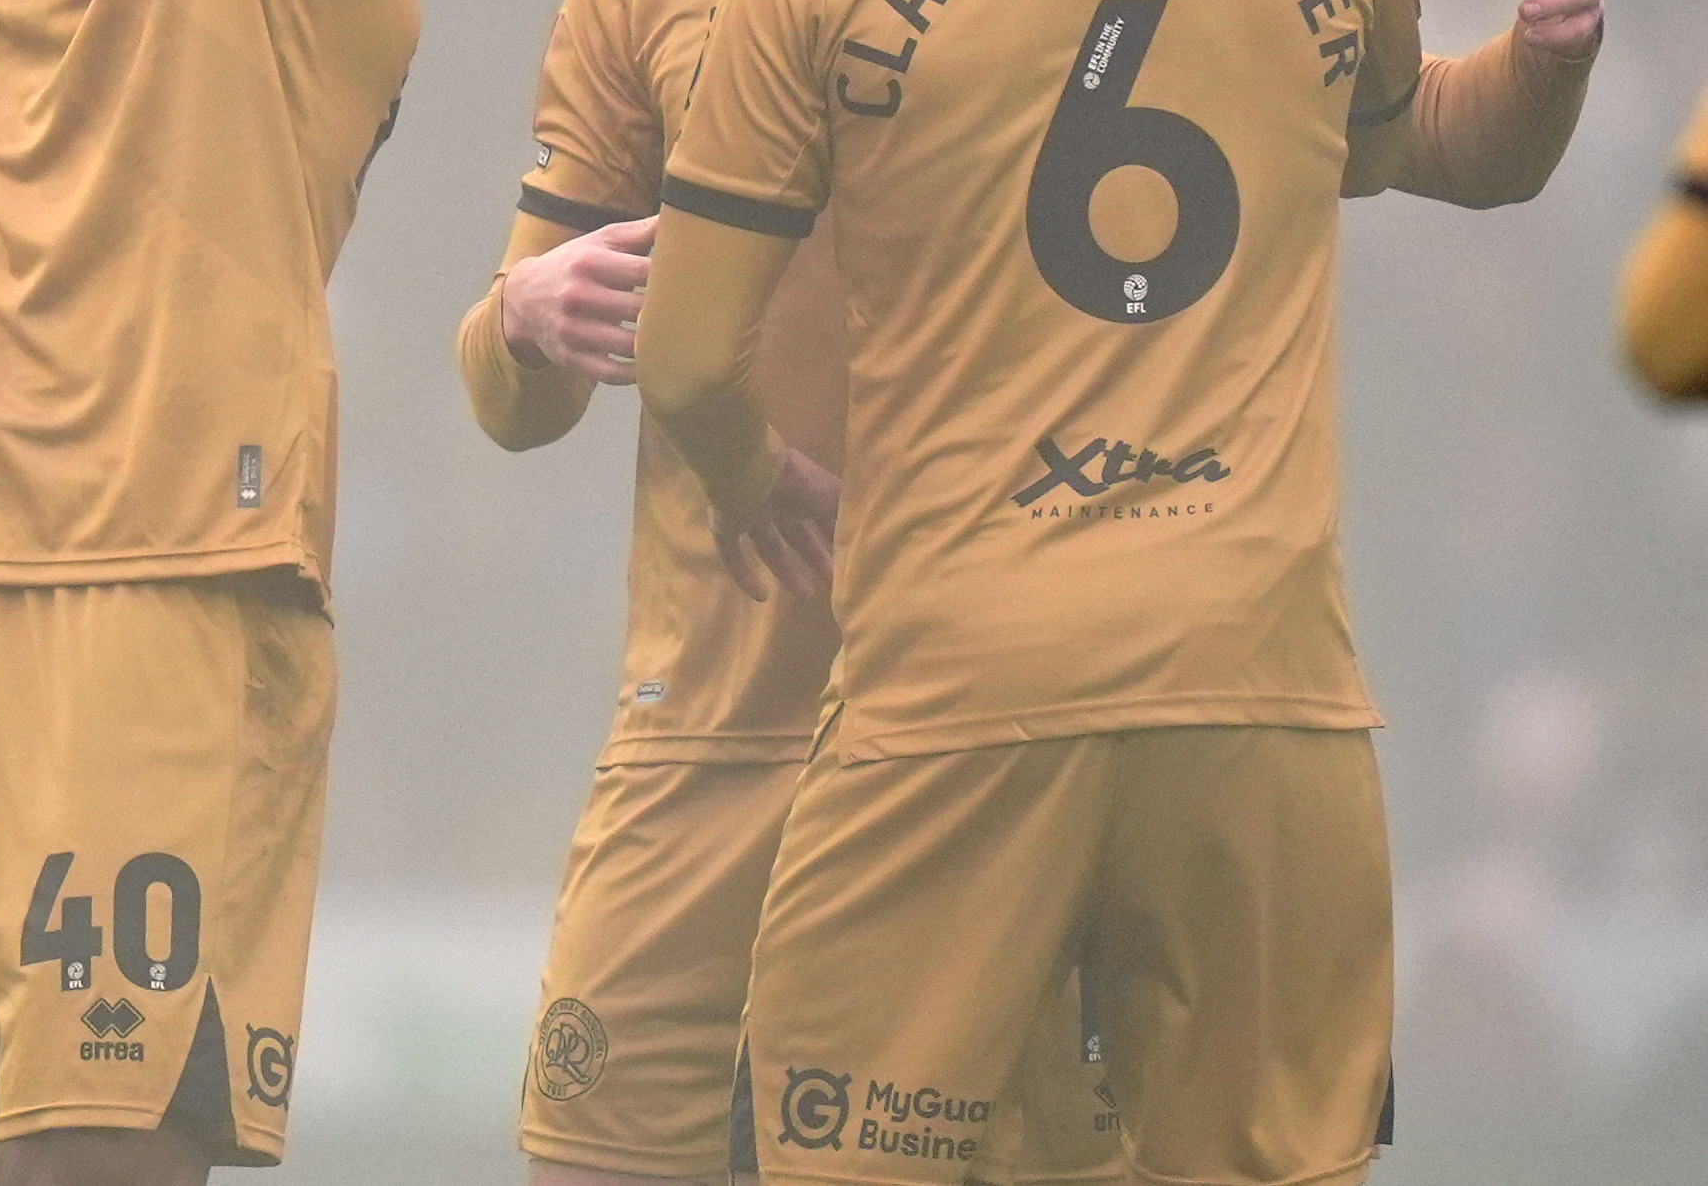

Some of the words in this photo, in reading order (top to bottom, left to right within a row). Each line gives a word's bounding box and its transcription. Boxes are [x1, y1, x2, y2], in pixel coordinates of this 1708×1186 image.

[1099, 22, 1113, 40] THE
[1094, 40, 1106, 53] IN
[1096, 16, 1125, 74] COMMUNITY
[1088, 54, 1102, 70] EFL
[1126, 302, 1147, 314] EFL
[1011, 437, 1231, 508] Xtra
[1031, 502, 1215, 520] MAINTENANCE
[20, 851, 201, 992] 40
[69, 980, 84, 989] EFL
[150, 980, 166, 990] EFL
[80, 1041, 145, 1062] errea
[865, 1079, 992, 1122] MyGua
[858, 1118, 979, 1161] Busine
